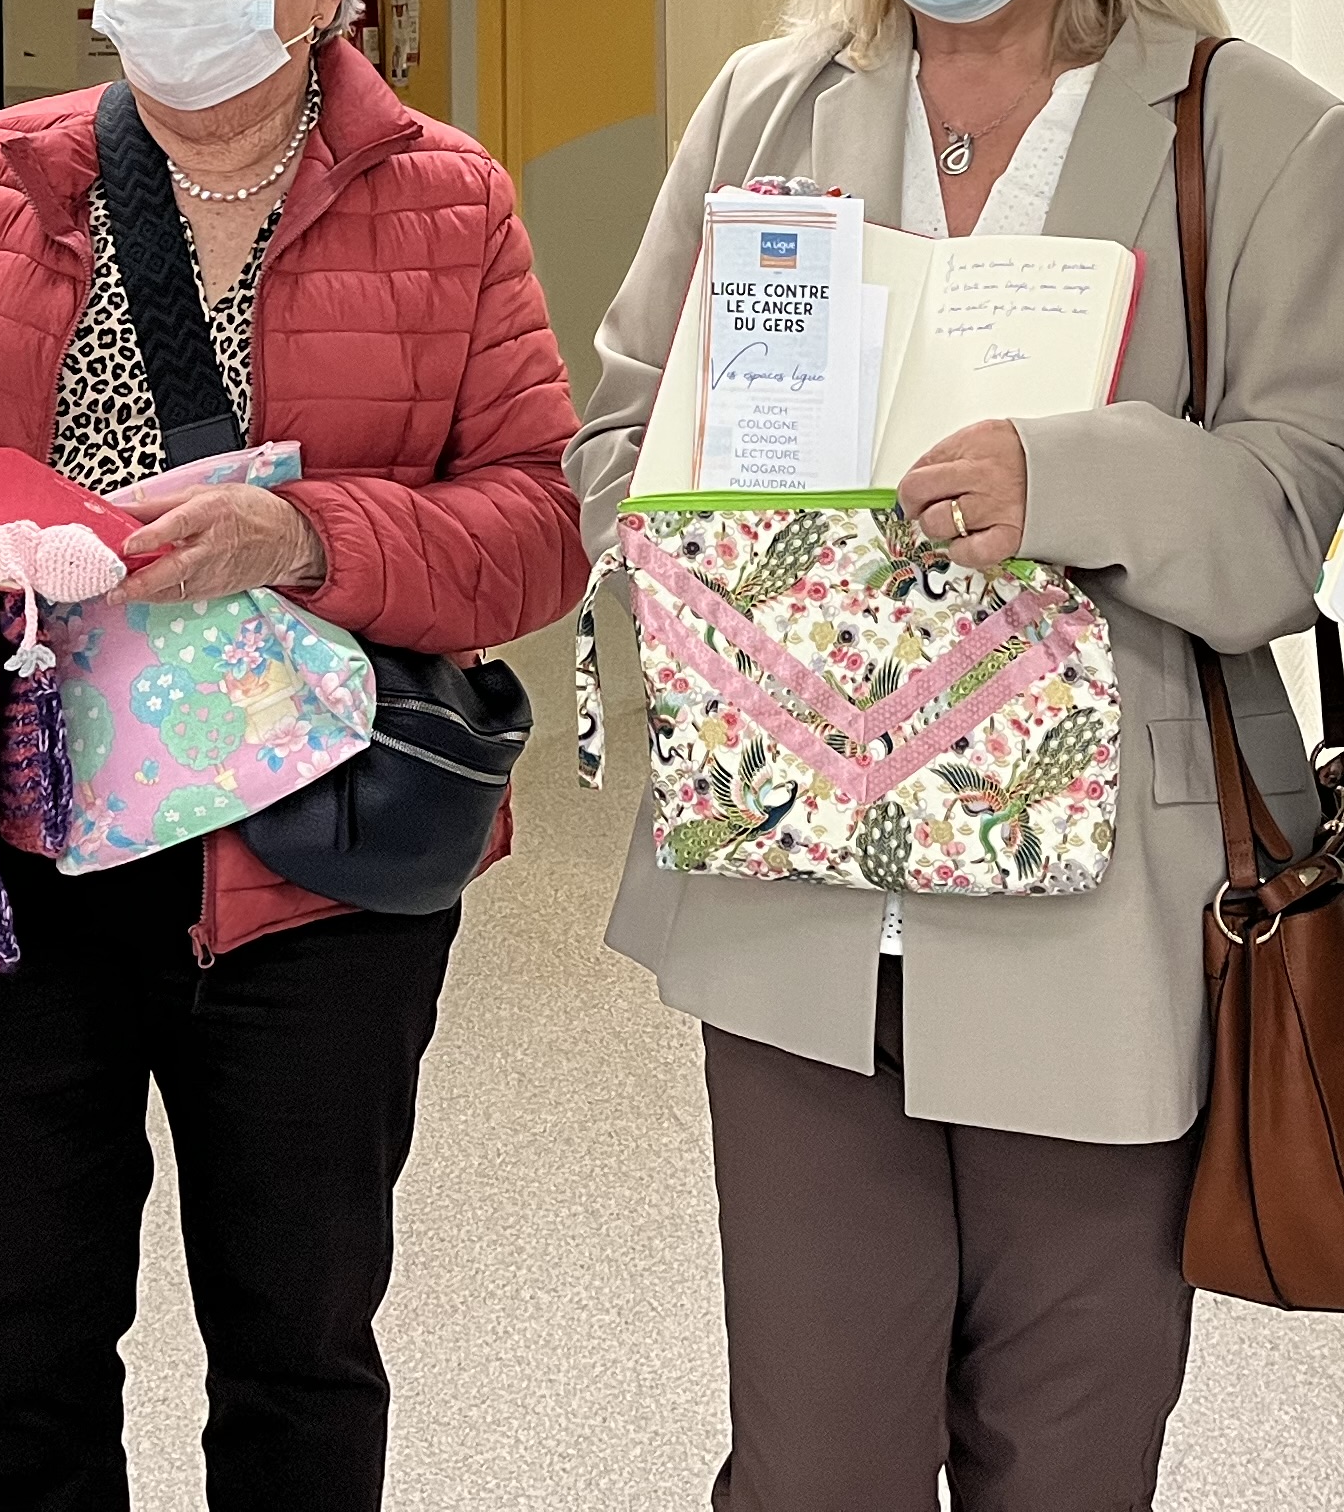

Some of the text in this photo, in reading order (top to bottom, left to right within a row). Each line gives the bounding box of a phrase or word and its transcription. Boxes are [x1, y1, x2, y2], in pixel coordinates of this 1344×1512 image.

[711, 281, 830, 300] LIGUE CONTRE
[726, 299, 813, 316] LE CANCER
[734, 316, 805, 333] DU GERS
[752, 405, 788, 416] AUCH
[737, 419, 799, 431] COLOGNE
[741, 434, 798, 445] CONDOM
[734, 448, 800, 461] LECTOURE
[740, 463, 796, 475] NOGARO
[729, 477, 806, 490] PUJAUDRAN
